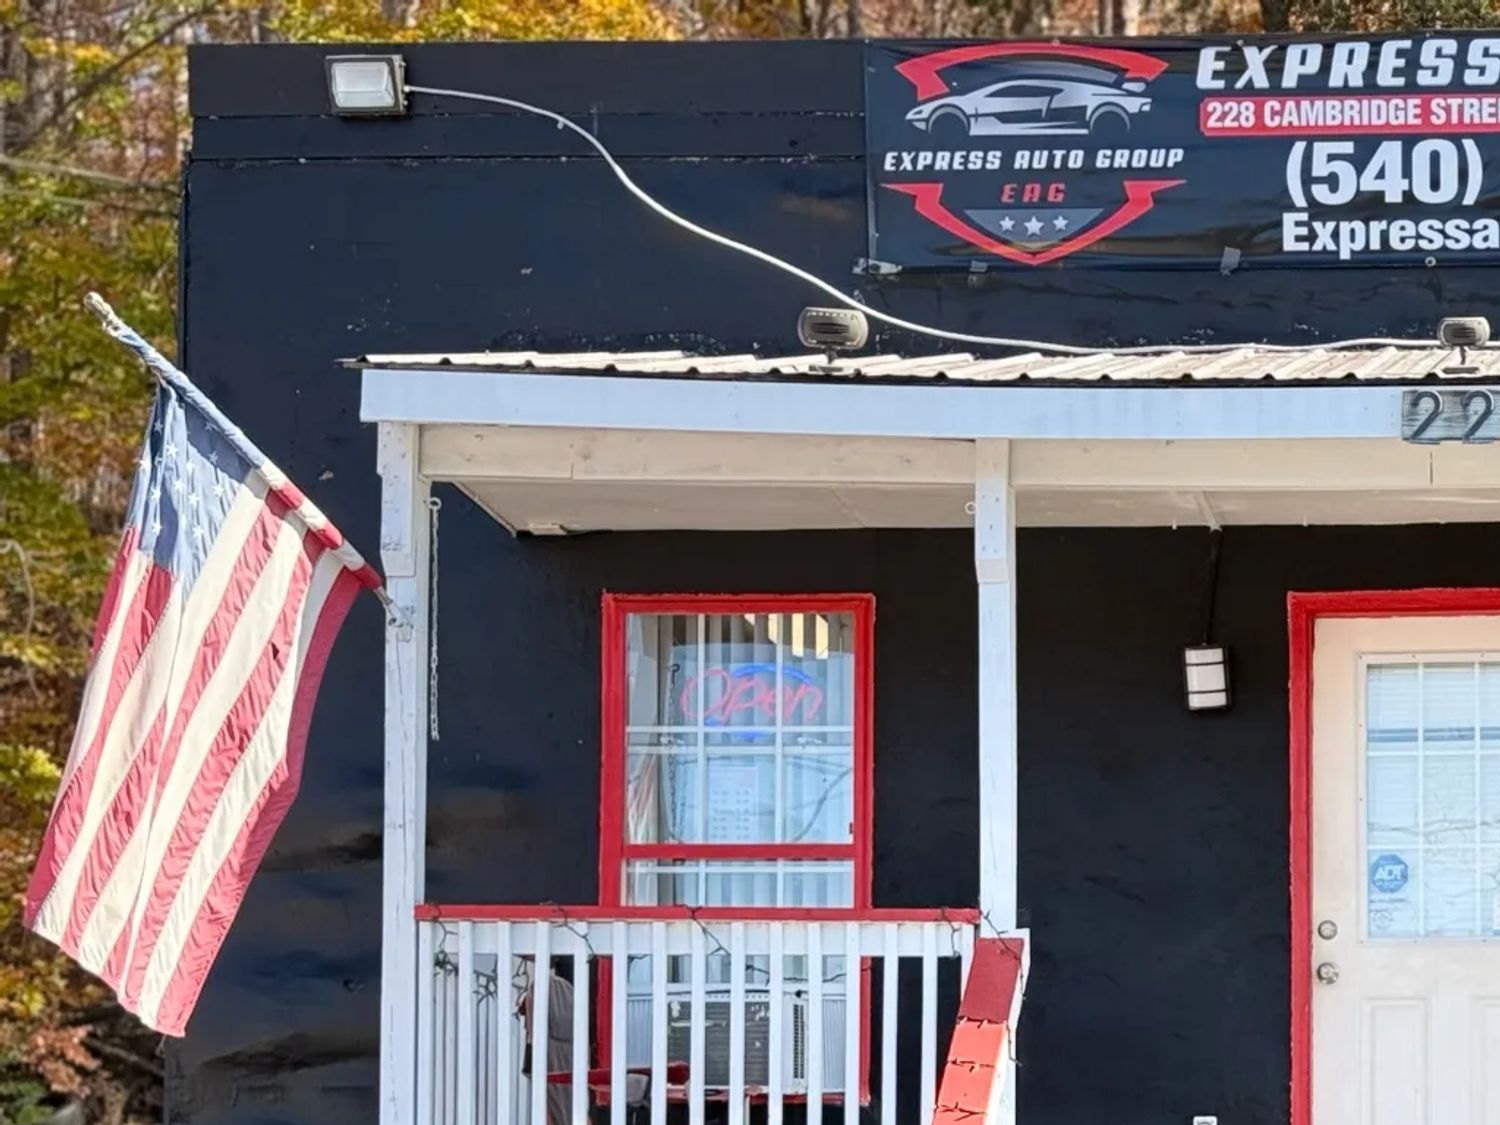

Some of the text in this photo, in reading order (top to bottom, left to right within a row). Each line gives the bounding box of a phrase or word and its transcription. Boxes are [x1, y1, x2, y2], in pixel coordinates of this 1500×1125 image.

[1206, 101, 1256, 129] 228
[1264, 98, 1423, 128] CAMBRIDGE
[883, 147, 1185, 171] EXPRESS AUTO GROUP
[1286, 139, 1483, 208] (540)
[1373, 864, 1406, 881] ADT
